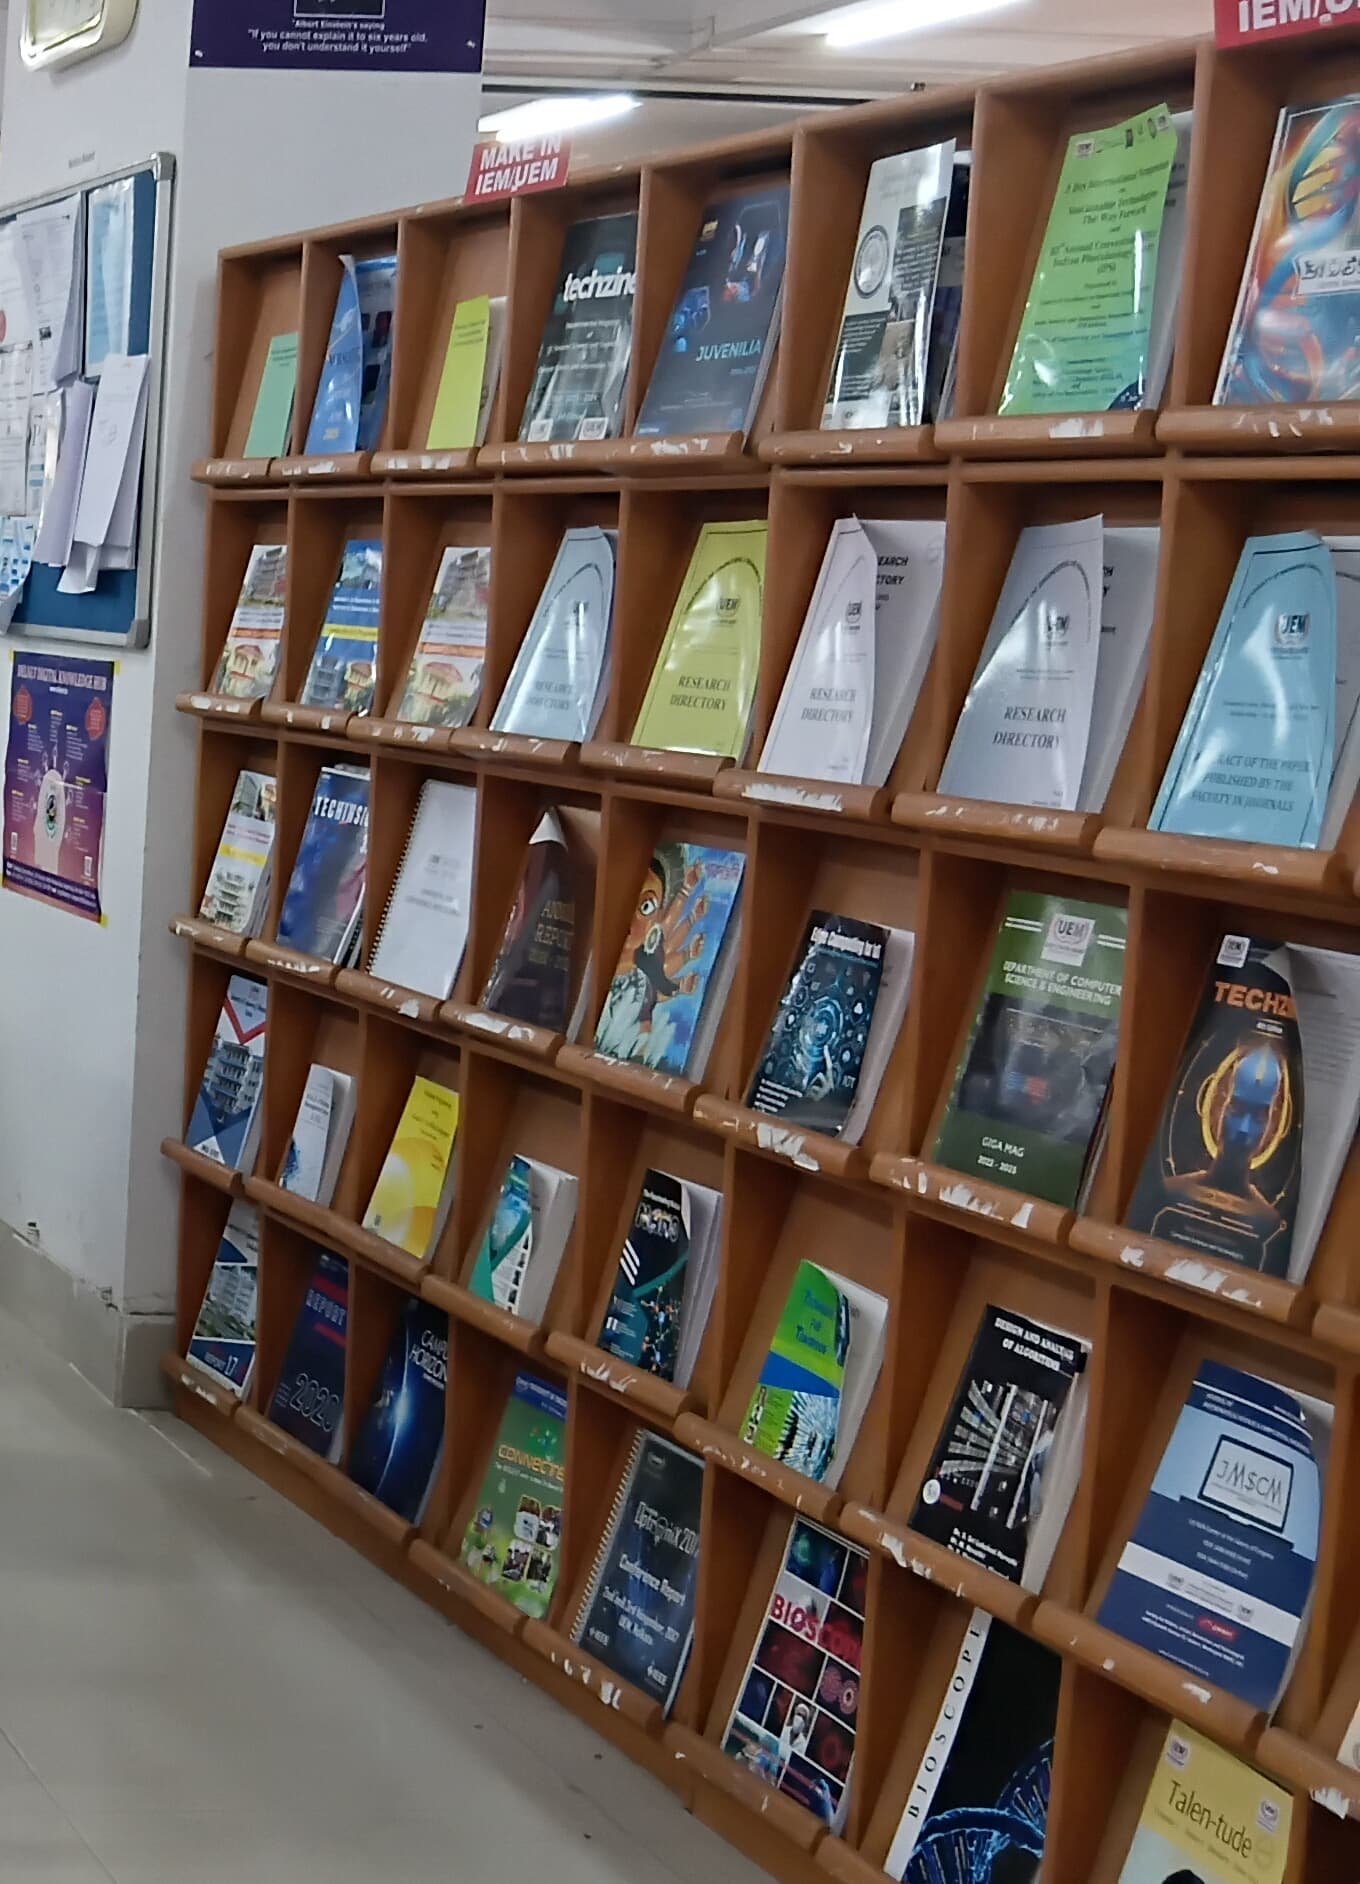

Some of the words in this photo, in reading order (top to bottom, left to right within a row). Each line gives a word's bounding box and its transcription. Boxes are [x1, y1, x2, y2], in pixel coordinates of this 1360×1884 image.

[261, 32, 277, 40] you
[313, 32, 345, 41] explain
[368, 33, 380, 41] six
[263, 42, 280, 51] you
[282, 42, 305, 50] don't
[307, 43, 359, 51] understand
[480, 143, 535, 171] MAKE
[695, 339, 761, 362] JUVENILIA
[670, 694, 727, 711] DIRECTORY
[1003, 706, 1066, 724] RESEARCH
[1056, 972, 1070, 983] OF
[1071, 976, 1122, 997] COMPUTER
[1167, 1779, 1253, 1859] Talen-tude
